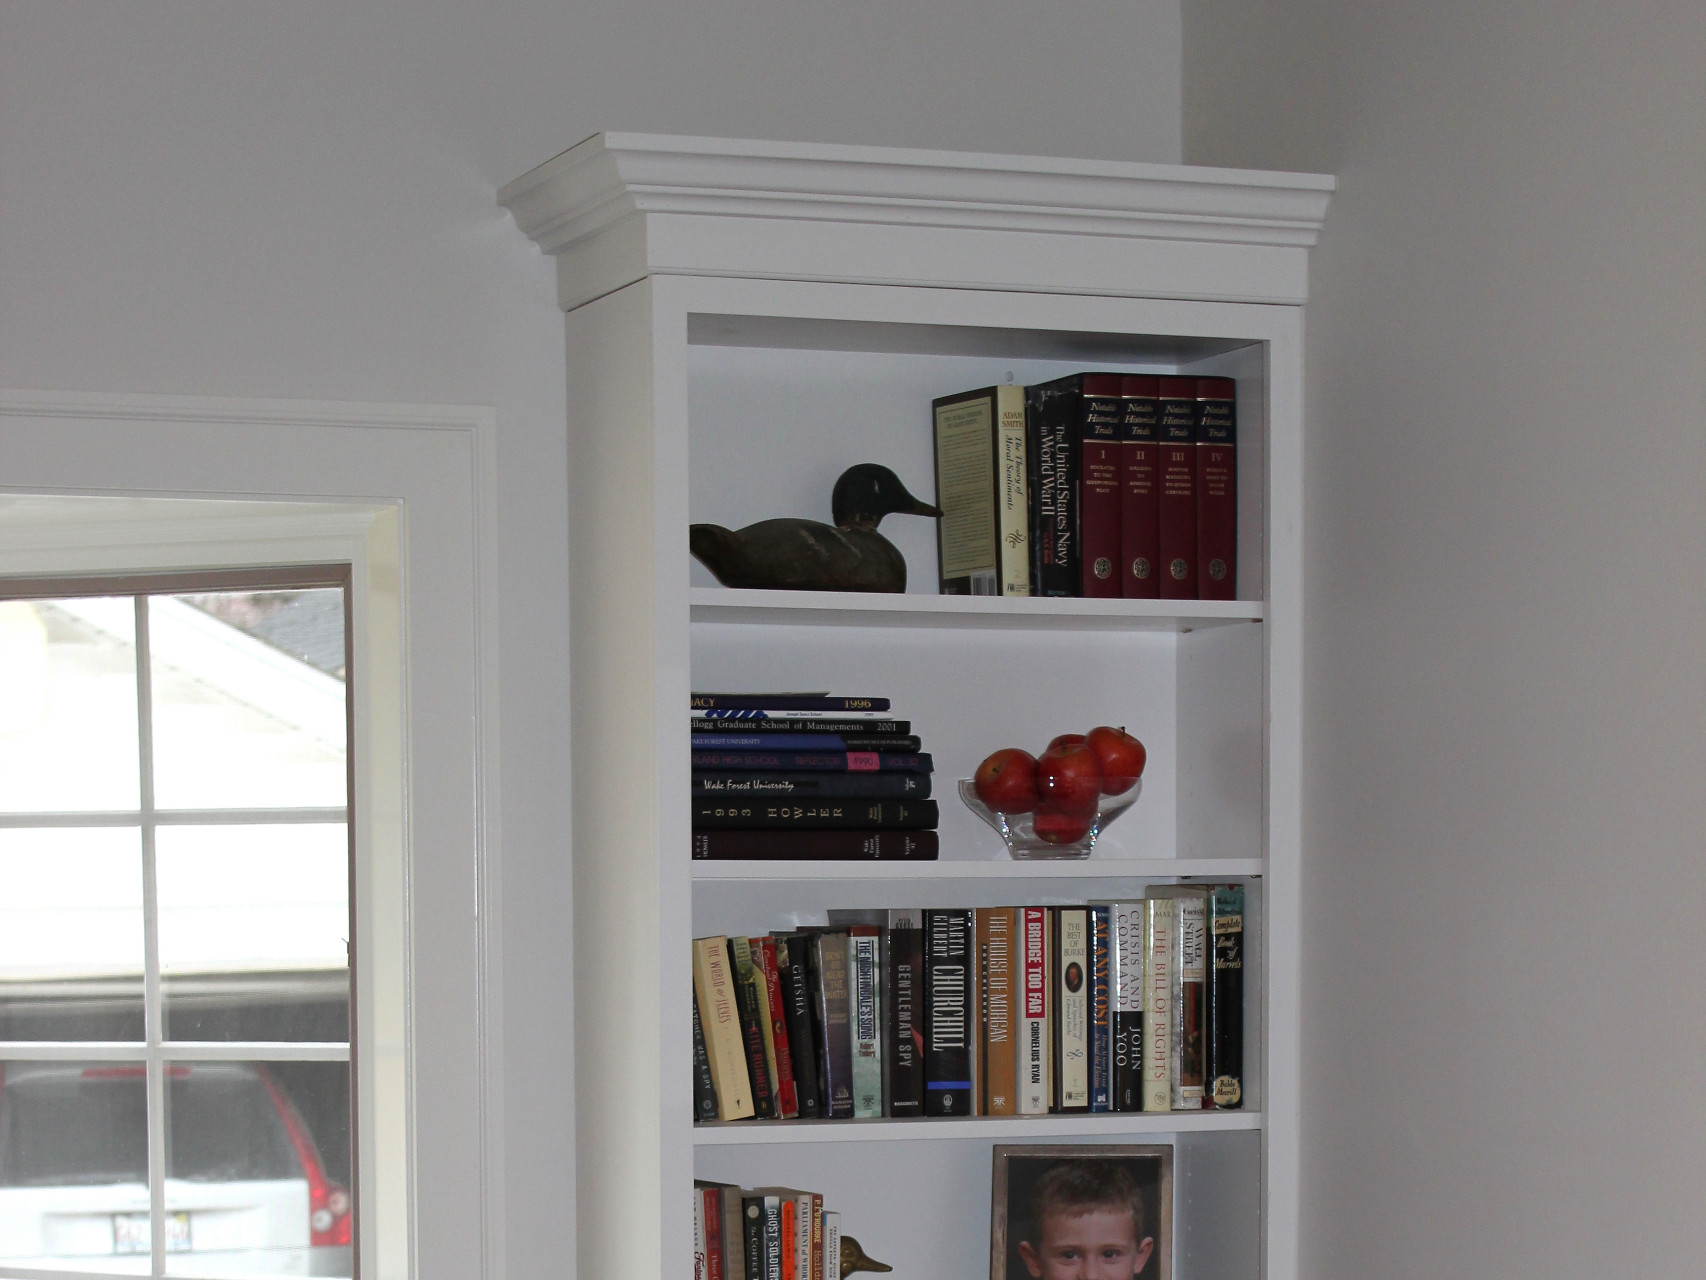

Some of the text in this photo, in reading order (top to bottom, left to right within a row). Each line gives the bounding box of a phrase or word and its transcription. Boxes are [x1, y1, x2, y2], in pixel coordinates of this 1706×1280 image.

[1003, 411, 1024, 420] ADAM
[1090, 402, 1117, 411] Notable
[1127, 404, 1154, 412] Notable
[1165, 405, 1191, 414] Notable
[1203, 406, 1230, 415] Notable
[1003, 421, 1025, 429] SMITH
[1086, 414, 1120, 423] Historical
[1125, 415, 1157, 423] Historical
[1162, 416, 1195, 425] Historical
[1201, 417, 1233, 426] Historical
[1041, 426, 1050, 436] in
[1095, 426, 1113, 434] Trials
[1132, 427, 1151, 435] Trials
[1169, 428, 1188, 437] Trials
[1041, 436, 1054, 475] World
[1101, 450, 1105, 459] I
[1136, 450, 1145, 460] II
[1172, 452, 1185, 461] III
[1211, 452, 1224, 462] IV
[1015, 455, 1023, 483] Theory
[1006, 463, 1014, 510] Sentiments
[1015, 486, 1023, 495] of
[1042, 477, 1055, 505] War
[1056, 425, 1071, 567] The United States Navy
[1042, 506, 1055, 515] II
[844, 699, 872, 709] 1996
[717, 719, 757, 729] Graduate
[761, 720, 791, 729] School
[794, 720, 803, 729] of
[807, 721, 864, 731] Managements
[877, 722, 896, 731] 2001
[704, 779, 795, 792] Wake Forest University
[767, 807, 844, 819] HOWLER
[1067, 923, 1082, 931] THE
[1215, 918, 1241, 932] Complete
[933, 915, 948, 958] GILBERT
[948, 916, 965, 956] MARTIN
[1185, 922, 1194, 967] STREET
[1194, 927, 1203, 962] WALL
[707, 945, 721, 958] THE
[1063, 949, 1086, 957] BURKE
[1118, 914, 1129, 1006] COMMAND
[1130, 910, 1140, 1010] CRISIS AND
[1027, 910, 1044, 1014] A BRIDGE TOO FAR
[1095, 946, 1109, 980] ANY
[1216, 957, 1242, 969] Marvels
[709, 960, 725, 986] WORLD
[763, 949, 777, 1011] Constant Princess
[989, 915, 1009, 1043] THE HOUSE OF MORGAN
[792, 964, 804, 1016] GEISHA
[831, 980, 844, 989] THE
[858, 940, 873, 1040] THE NIGHTINGALE'S SONG
[716, 998, 731, 1023] JEEVES
[932, 965, 965, 1052] CHURCHILL
[1096, 984, 1109, 1029] COST
[1154, 930, 1167, 1079] THE BILL OF RIGHTS
[898, 965, 912, 1067] GENTLEMAN SPY
[749, 1026, 762, 1051] KITE
[1030, 1021, 1041, 1084] CORNELIUS RYAN
[1116, 1032, 1128, 1067] YOO
[1129, 1027, 1142, 1070] JOHN
[752, 1052, 768, 1097] RUNNER
[767, 1208, 777, 1237] GHOST
[751, 1237, 759, 1273] COFFEE
